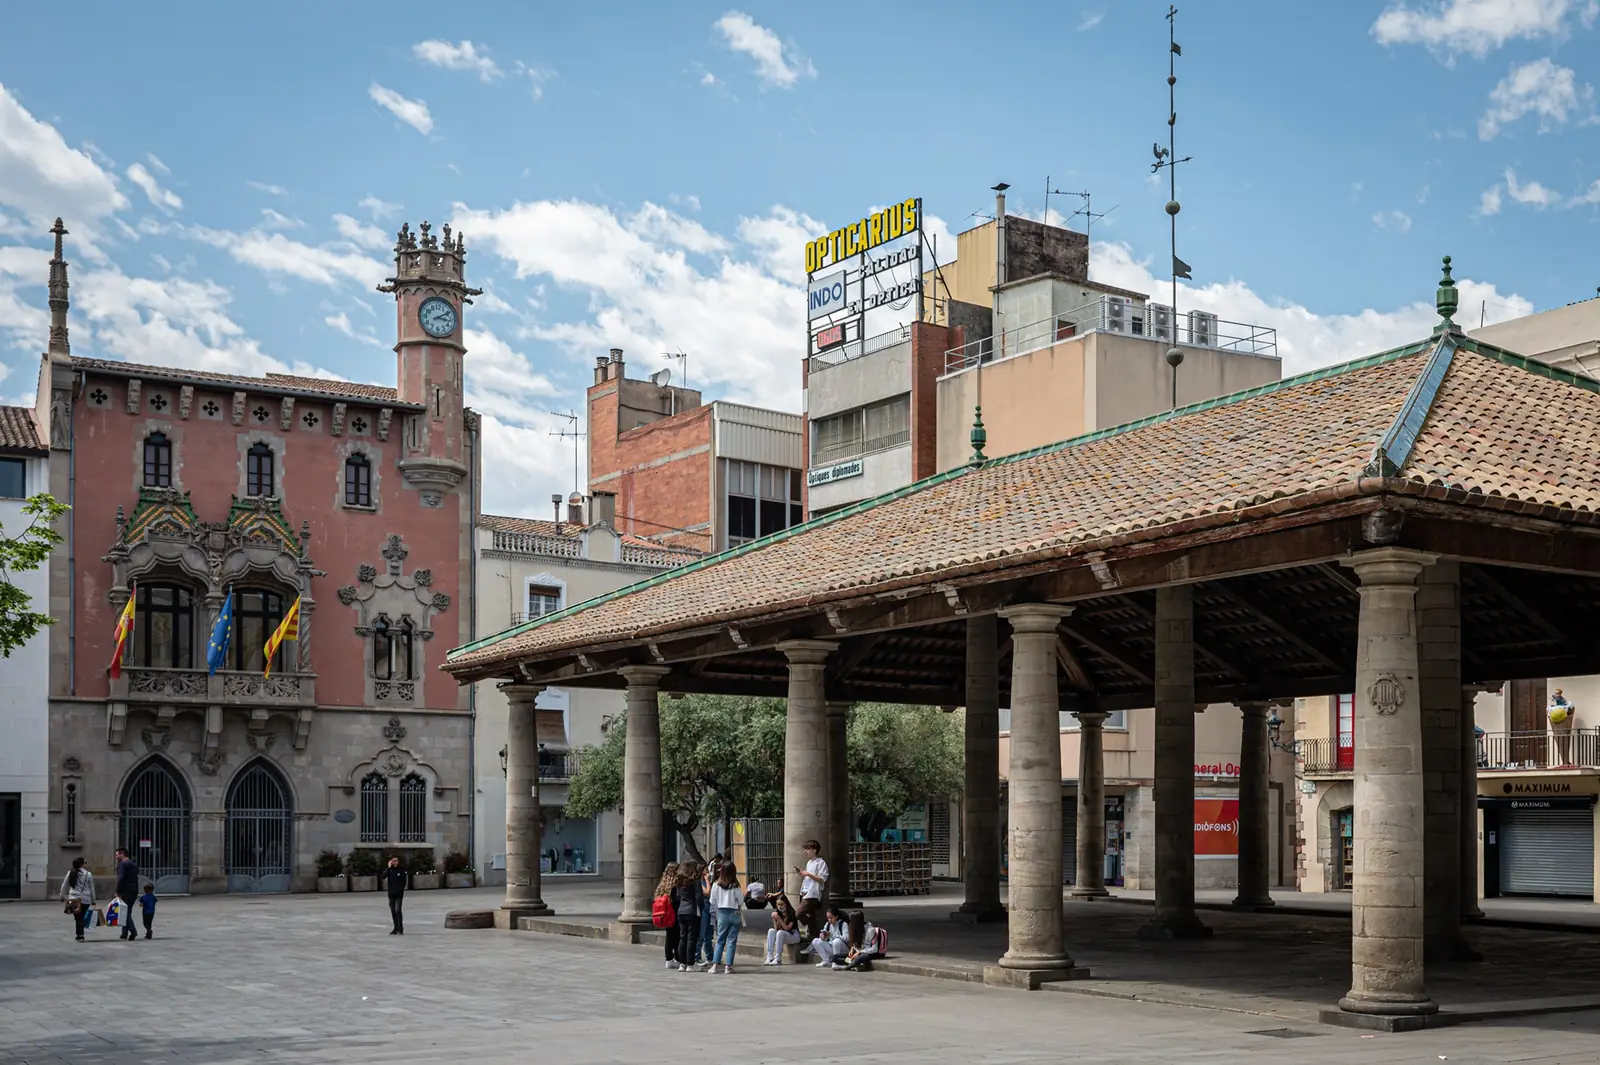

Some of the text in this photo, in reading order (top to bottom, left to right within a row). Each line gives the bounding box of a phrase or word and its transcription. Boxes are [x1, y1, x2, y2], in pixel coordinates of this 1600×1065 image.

[805, 198, 917, 273] OPTICARIUS
[858, 245, 917, 278] CALIDAD
[810, 282, 842, 310] INDO
[848, 278, 917, 316] EN OPTICA
[808, 463, 860, 484] Optiques diplomades
[1514, 784, 1570, 792] MAXIMUM
